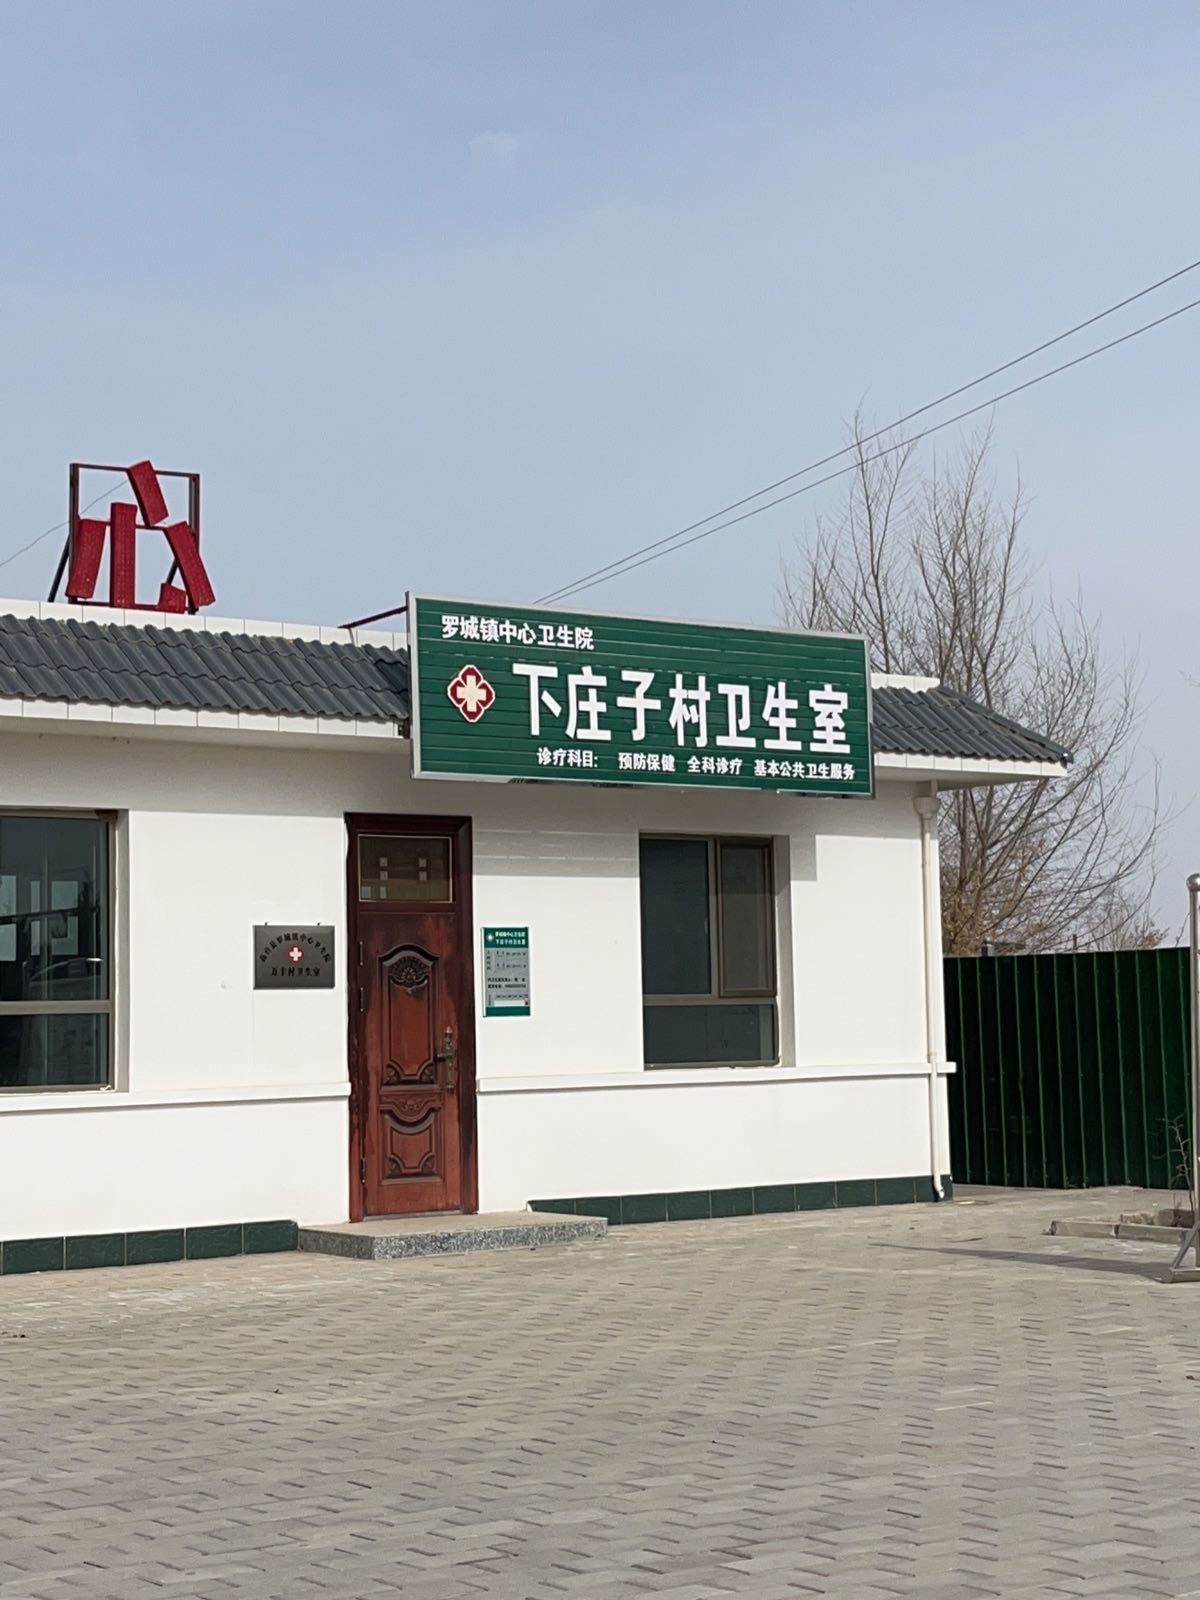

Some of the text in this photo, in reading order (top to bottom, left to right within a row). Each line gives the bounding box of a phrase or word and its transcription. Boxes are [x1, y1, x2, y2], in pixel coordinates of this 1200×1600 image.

[441, 615, 594, 650] 罗城镇中心卫生院
[512, 662, 851, 754] 下庄子村卫生室
[618, 752, 676, 772] 预防保健
[687, 755, 743, 775] 全科诊疗
[754, 759, 855, 780] 基本公共卫生服务
